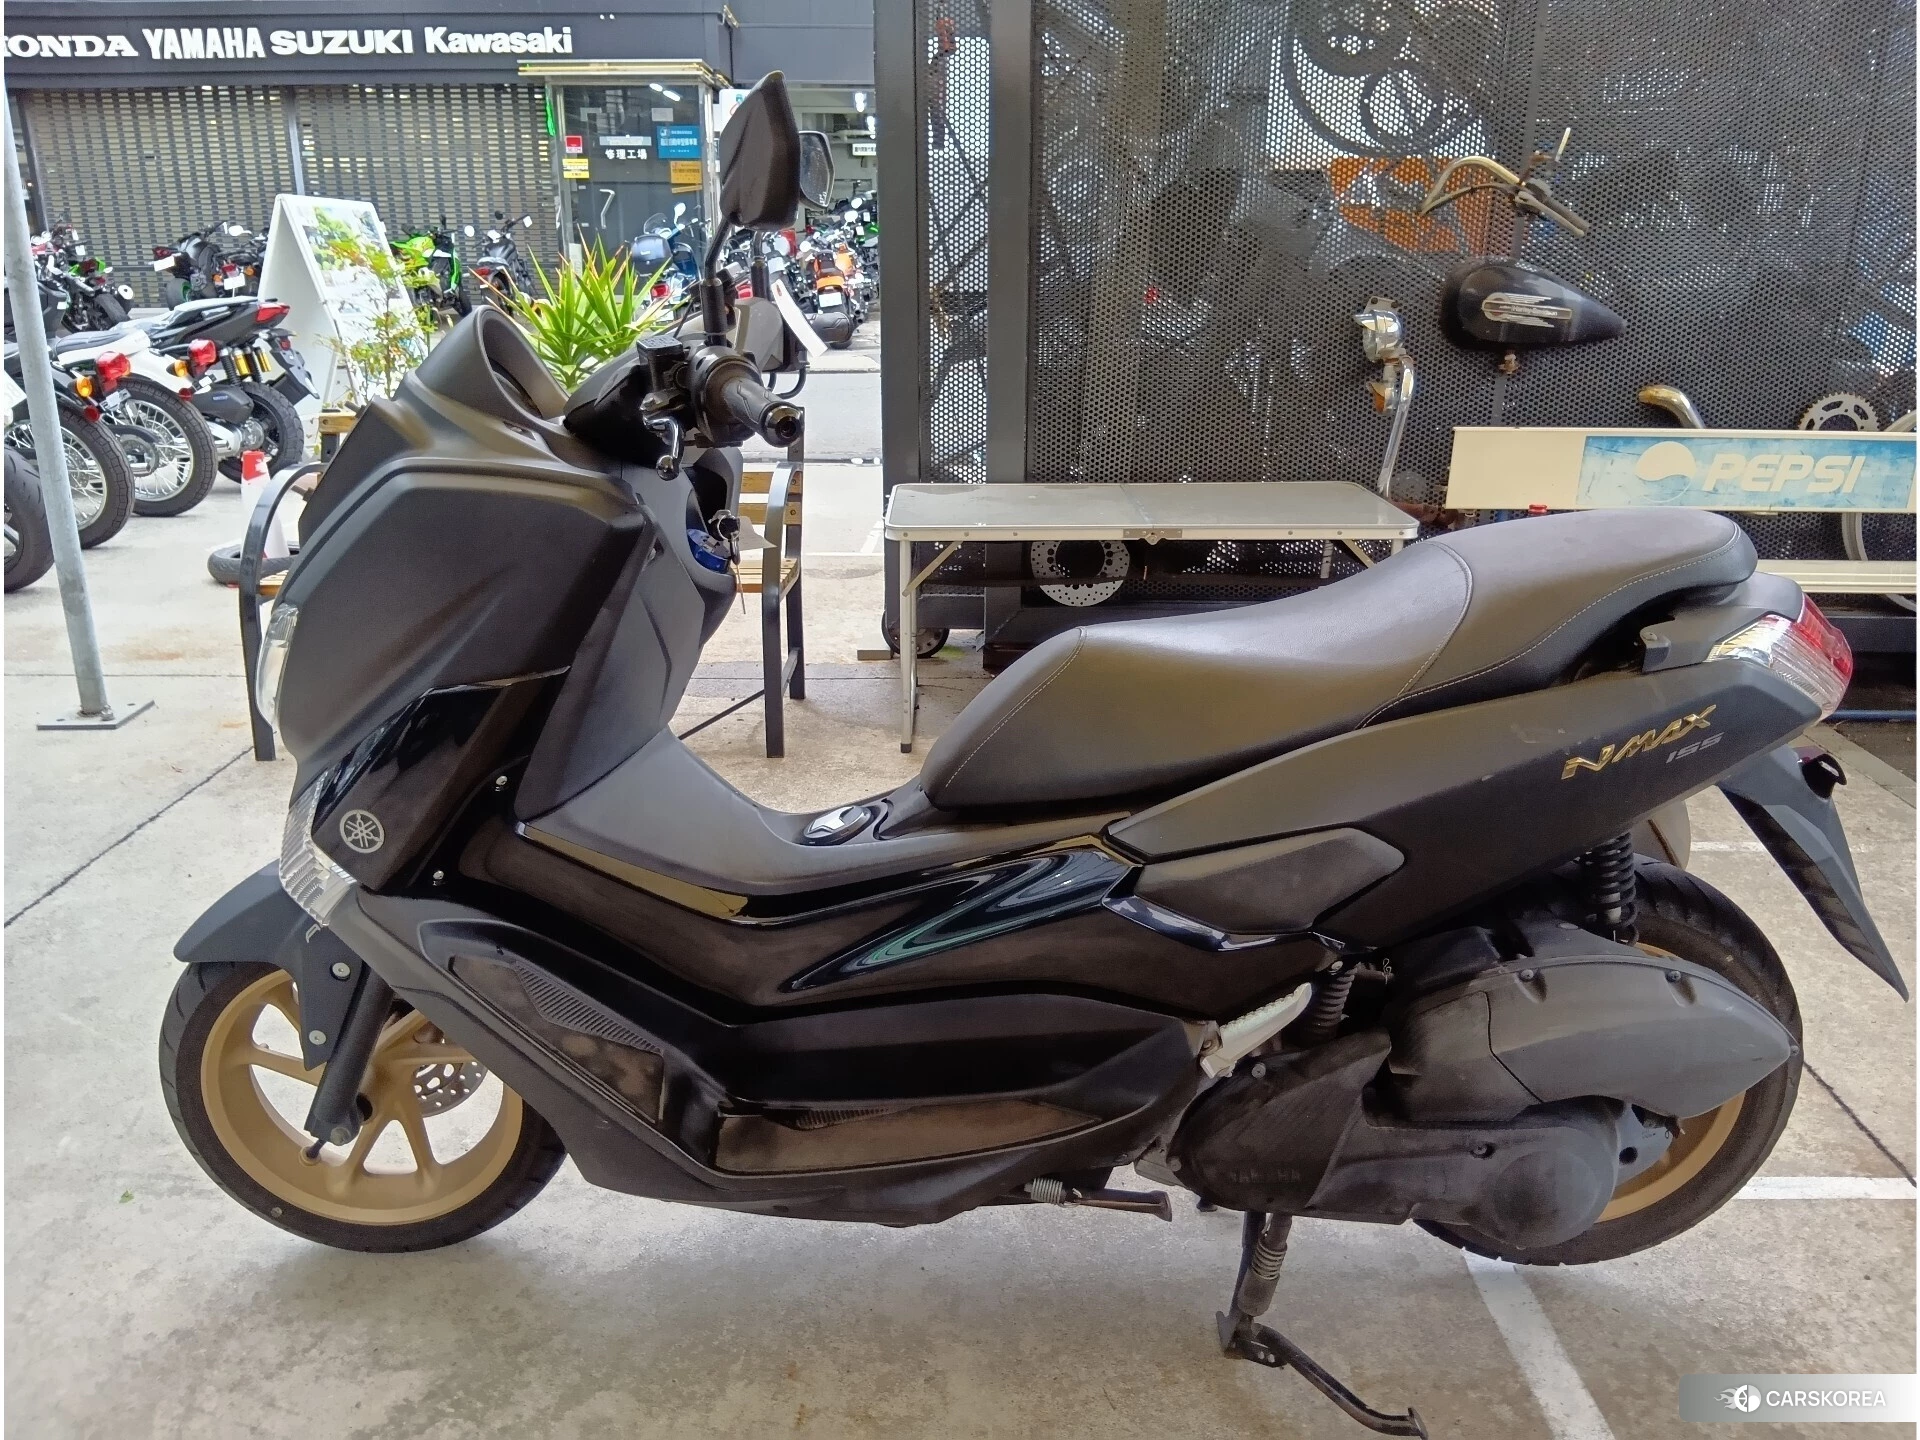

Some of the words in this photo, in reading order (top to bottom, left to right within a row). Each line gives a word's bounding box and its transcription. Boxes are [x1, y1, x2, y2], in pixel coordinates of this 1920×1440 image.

[4, 34, 139, 58] ONDA
[141, 27, 267, 60] YAMAHA
[269, 29, 414, 55] SUZUKI
[424, 26, 573, 54] Kawasaki
[1701, 453, 1867, 493] PEPSI
[1561, 704, 1717, 781] NMAX
